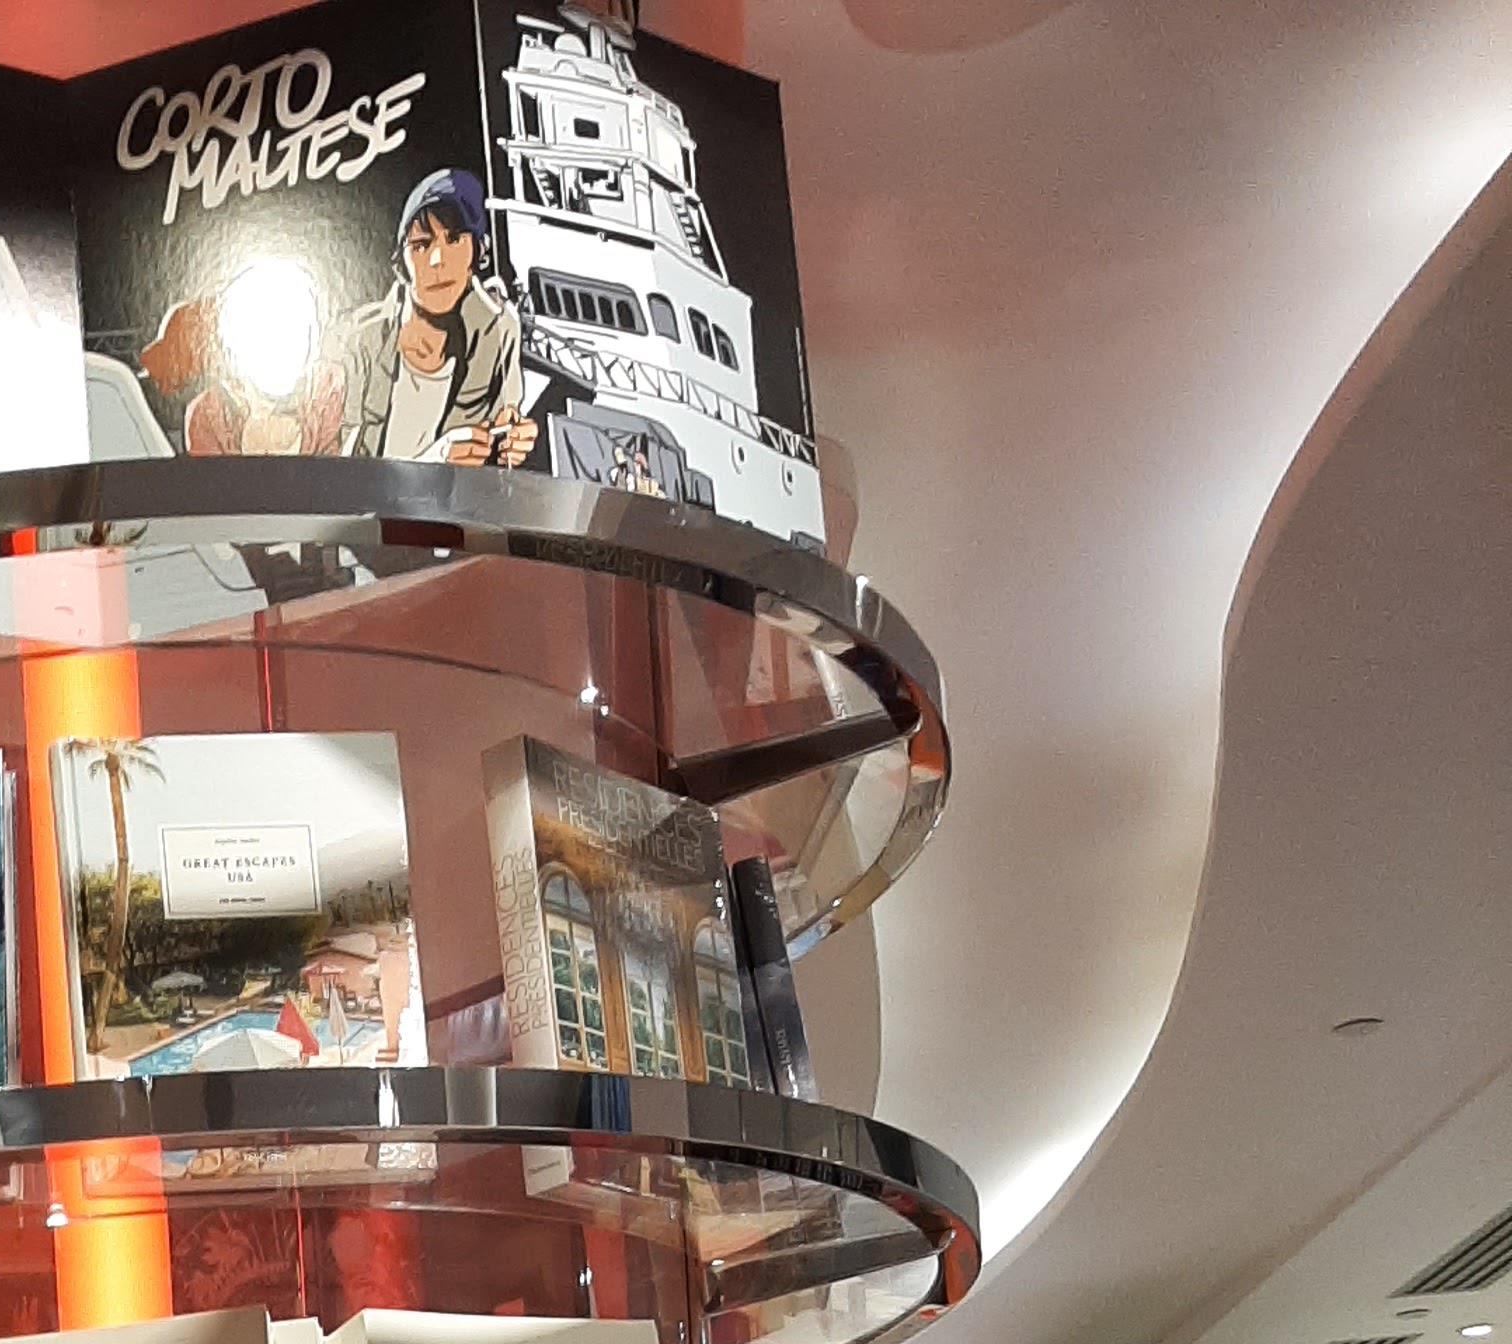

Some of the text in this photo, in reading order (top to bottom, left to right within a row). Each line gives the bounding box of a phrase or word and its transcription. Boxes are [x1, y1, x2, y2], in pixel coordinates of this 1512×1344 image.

[116, 49, 333, 172] CORTO
[162, 73, 426, 226] MALTESE
[183, 856, 295, 869] GREAT ESCAPES
